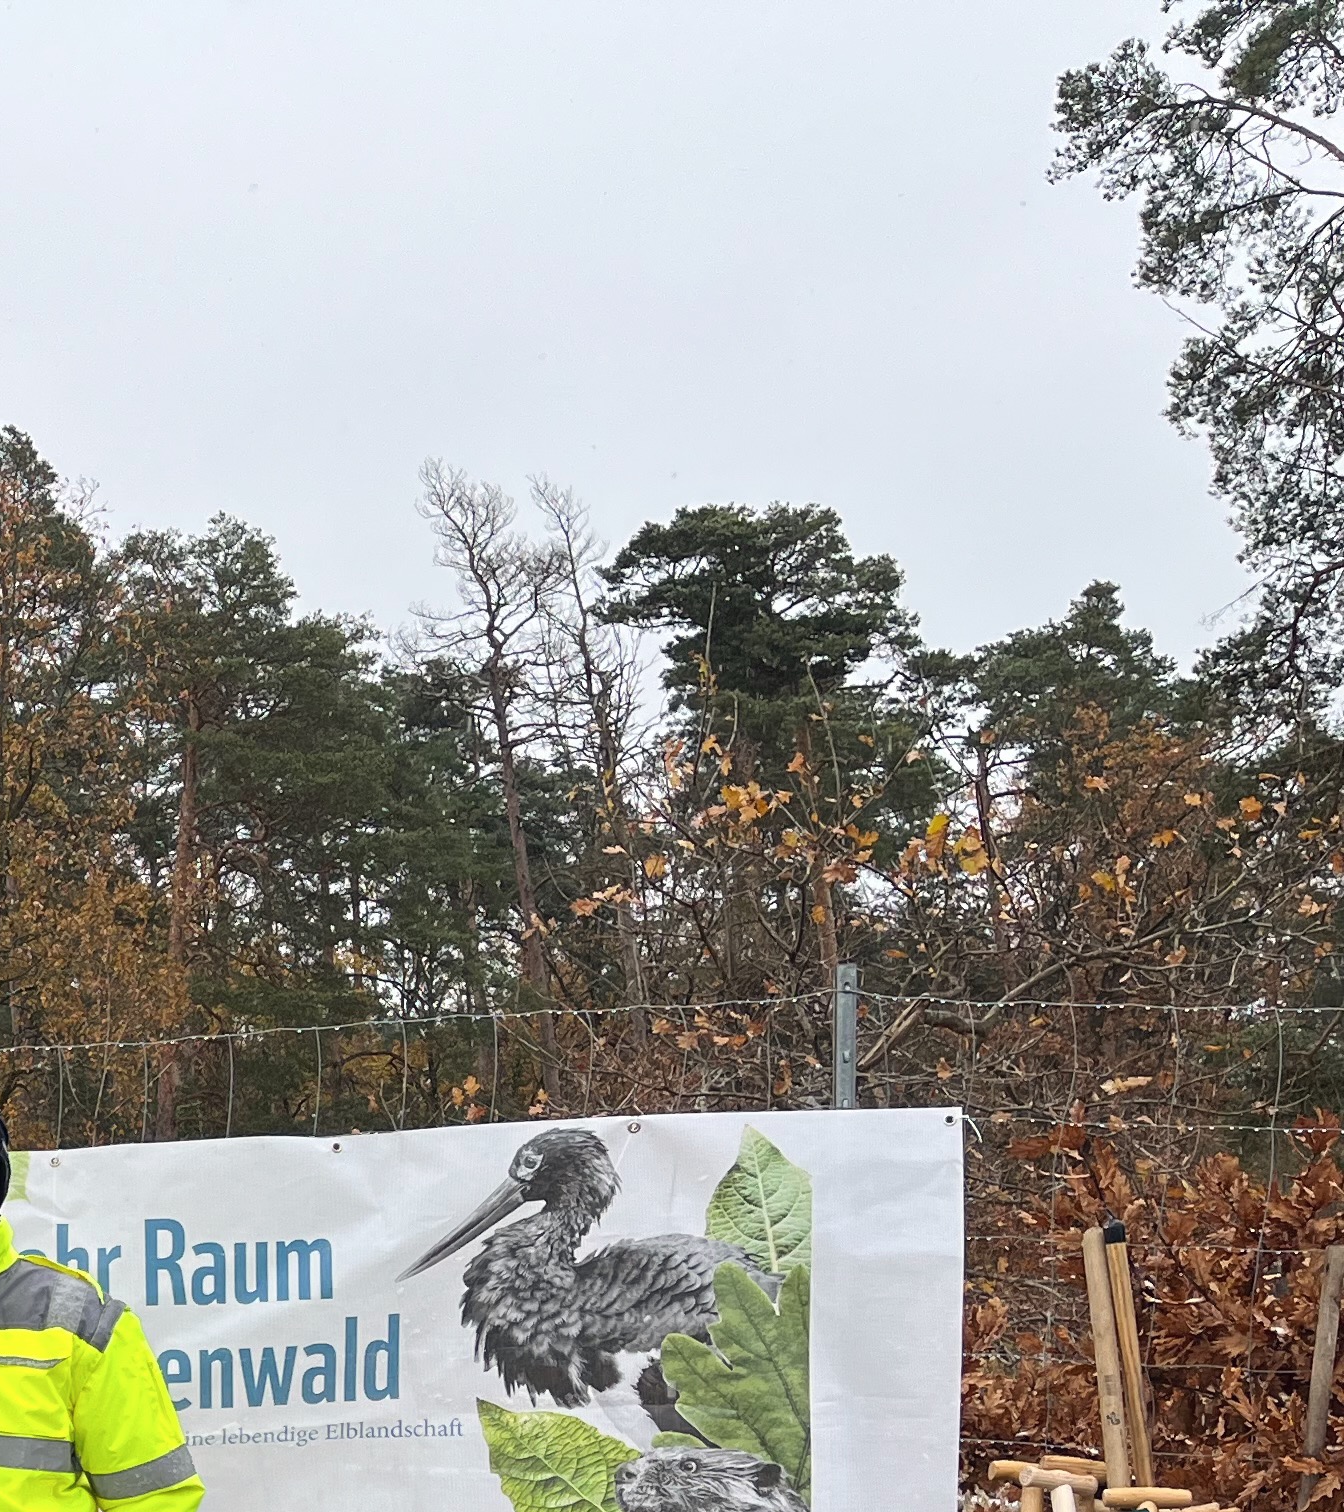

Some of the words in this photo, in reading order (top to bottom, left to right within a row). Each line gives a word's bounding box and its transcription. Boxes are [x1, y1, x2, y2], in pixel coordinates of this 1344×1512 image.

[18, 1223, 121, 1295] hr
[144, 1218, 333, 1306] Raum
[156, 1313, 401, 1412] enwald
[185, 1430, 216, 1447] ine
[221, 1425, 319, 1447] lebendige
[324, 1417, 464, 1441] Elblandschaft
